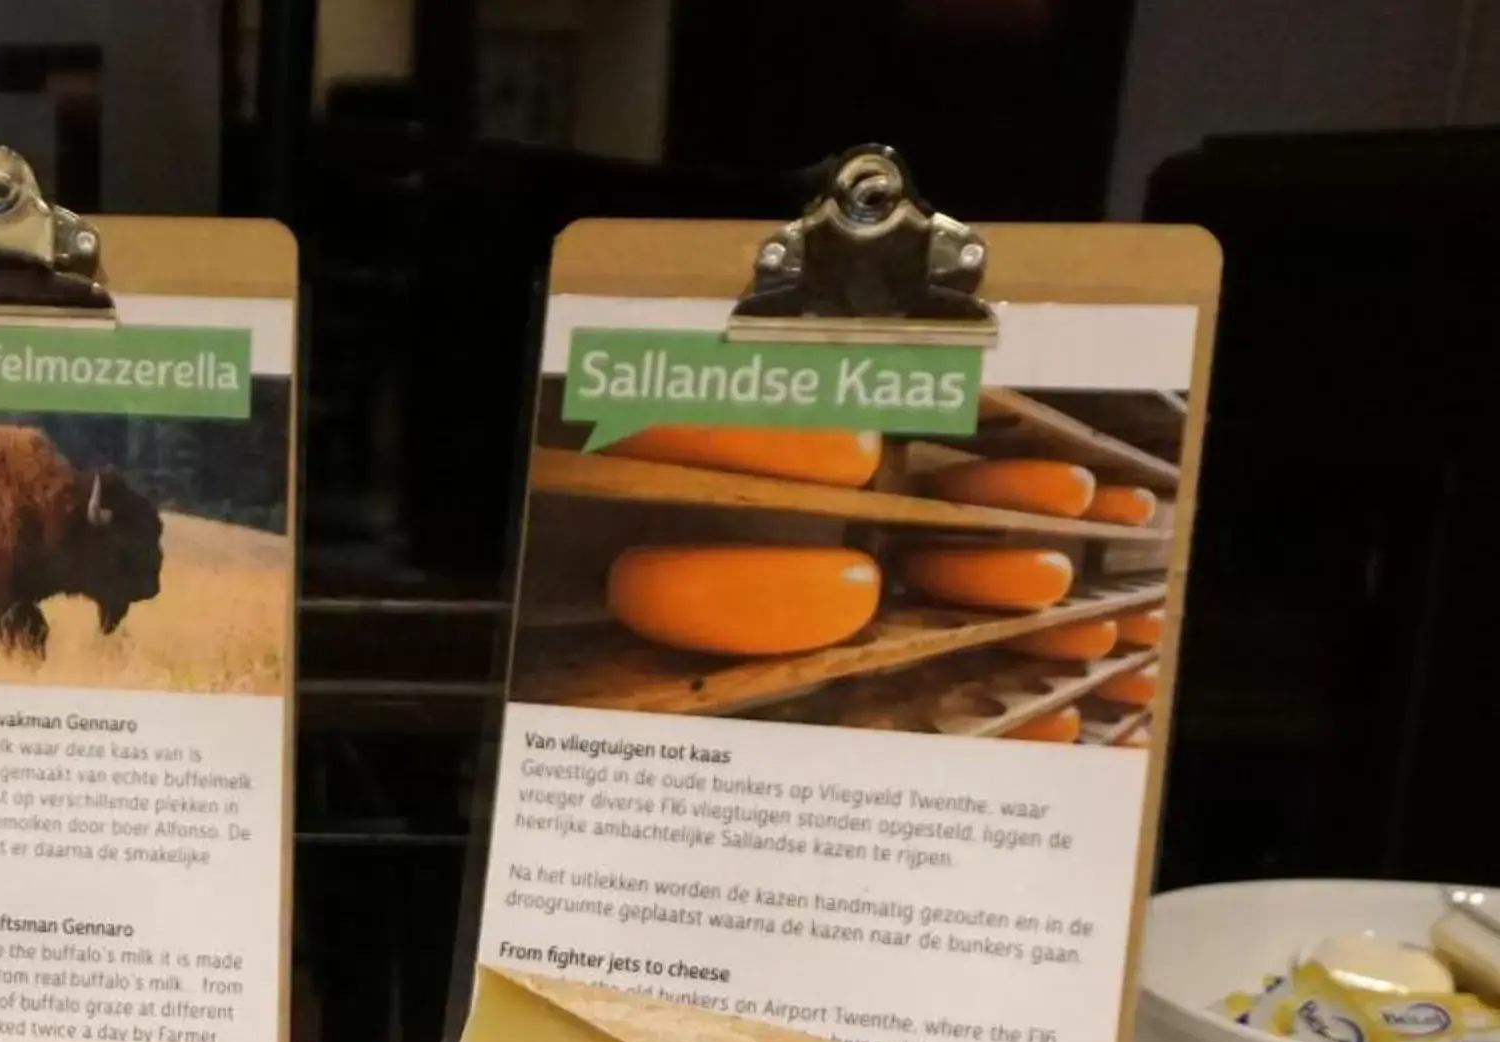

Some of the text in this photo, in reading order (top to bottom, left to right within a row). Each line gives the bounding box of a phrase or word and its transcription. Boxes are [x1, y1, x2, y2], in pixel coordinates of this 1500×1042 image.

[578, 350, 966, 409] Sallandse Kaas
[66, 713, 137, 733] Gennaro
[524, 732, 731, 765] Van vliegtuigen tot kaas
[521, 762, 607, 788] Gevestigd
[613, 769, 629, 787] in
[634, 770, 656, 789] de
[661, 774, 706, 793] oude
[712, 776, 783, 799] bunkers
[789, 787, 812, 804] op
[819, 784, 902, 808] Vliegveld
[1000, 803, 1049, 819] waar
[515, 813, 586, 838] heerlijke
[592, 822, 715, 849] ambachtelijke
[721, 830, 806, 854] Sallandse
[813, 838, 866, 860] kazen
[872, 845, 892, 862] te
[519, 792, 584, 812] vroeger
[590, 794, 655, 816] diverse
[692, 802, 790, 828] vliegtuigen
[797, 813, 871, 833] stonden
[1049, 830, 1072, 849] de
[505, 892, 613, 919] droogruimte
[618, 905, 702, 927] geplaatst
[708, 916, 775, 934] waarna
[781, 918, 804, 937] de
[809, 920, 864, 942] kazen
[870, 931, 911, 947] naar
[918, 931, 941, 949] de
[948, 933, 1023, 957] bunkers
[509, 866, 1092, 936] Na het uitlekken worden de kazen handmatig gezouten en in de
[61, 917, 135, 937] Gennaro
[499, 943, 730, 983] From fighter jets to cheese
[735, 1000, 756, 1014] on
[763, 999, 827, 1023] Airport
[924, 1019, 983, 1040] where
